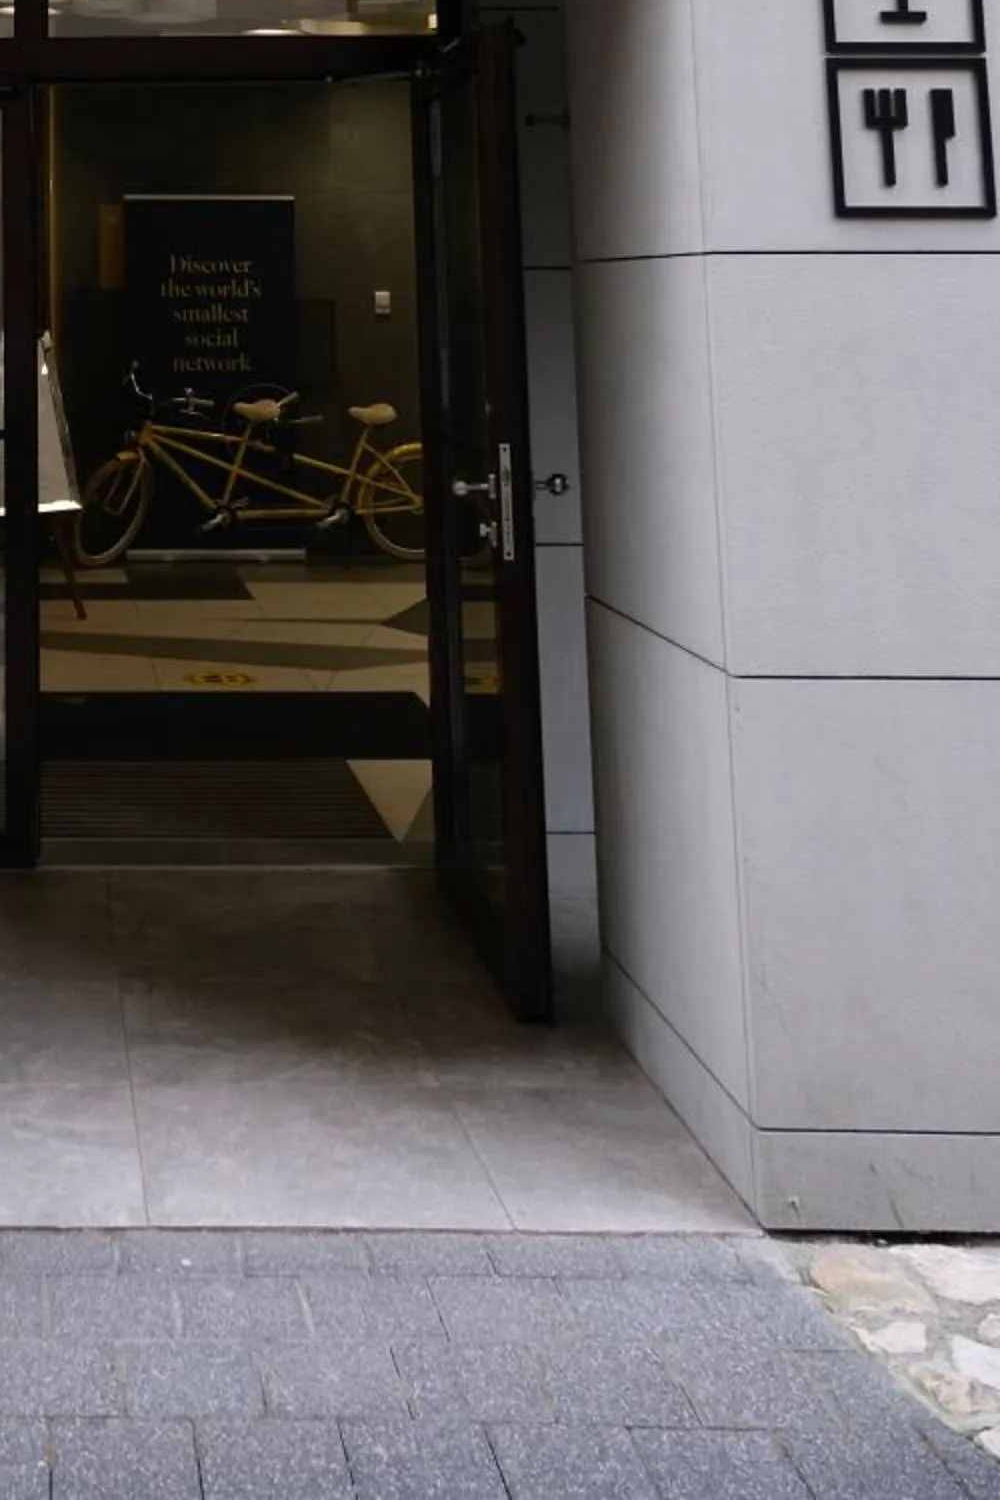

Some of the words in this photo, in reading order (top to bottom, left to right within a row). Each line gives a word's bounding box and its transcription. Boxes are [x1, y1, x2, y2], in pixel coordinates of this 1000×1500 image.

[170, 253, 254, 274] Discover
[160, 277, 192, 298] the
[173, 301, 249, 322] smallest
[185, 327, 238, 347] social
[172, 351, 253, 373] network
